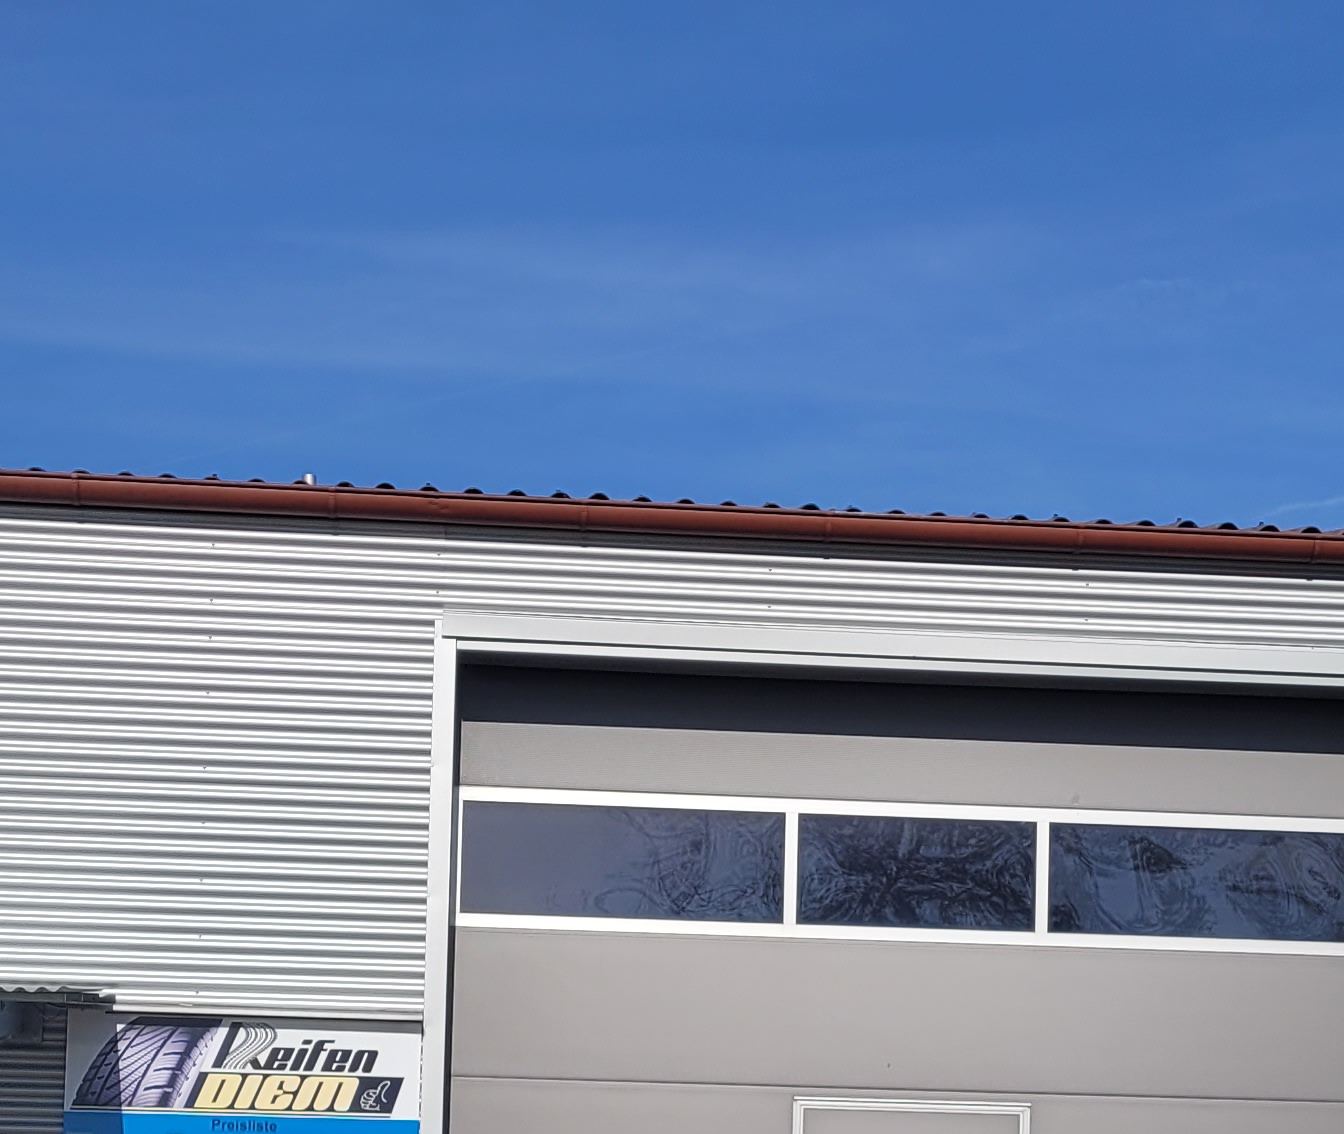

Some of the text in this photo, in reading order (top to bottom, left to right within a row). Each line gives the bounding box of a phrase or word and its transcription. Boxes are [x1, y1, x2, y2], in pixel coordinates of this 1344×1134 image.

[211, 1022, 379, 1074] Reifen
[194, 1072, 359, 1112] DIEM
[211, 1119, 278, 1132] Preisliste
